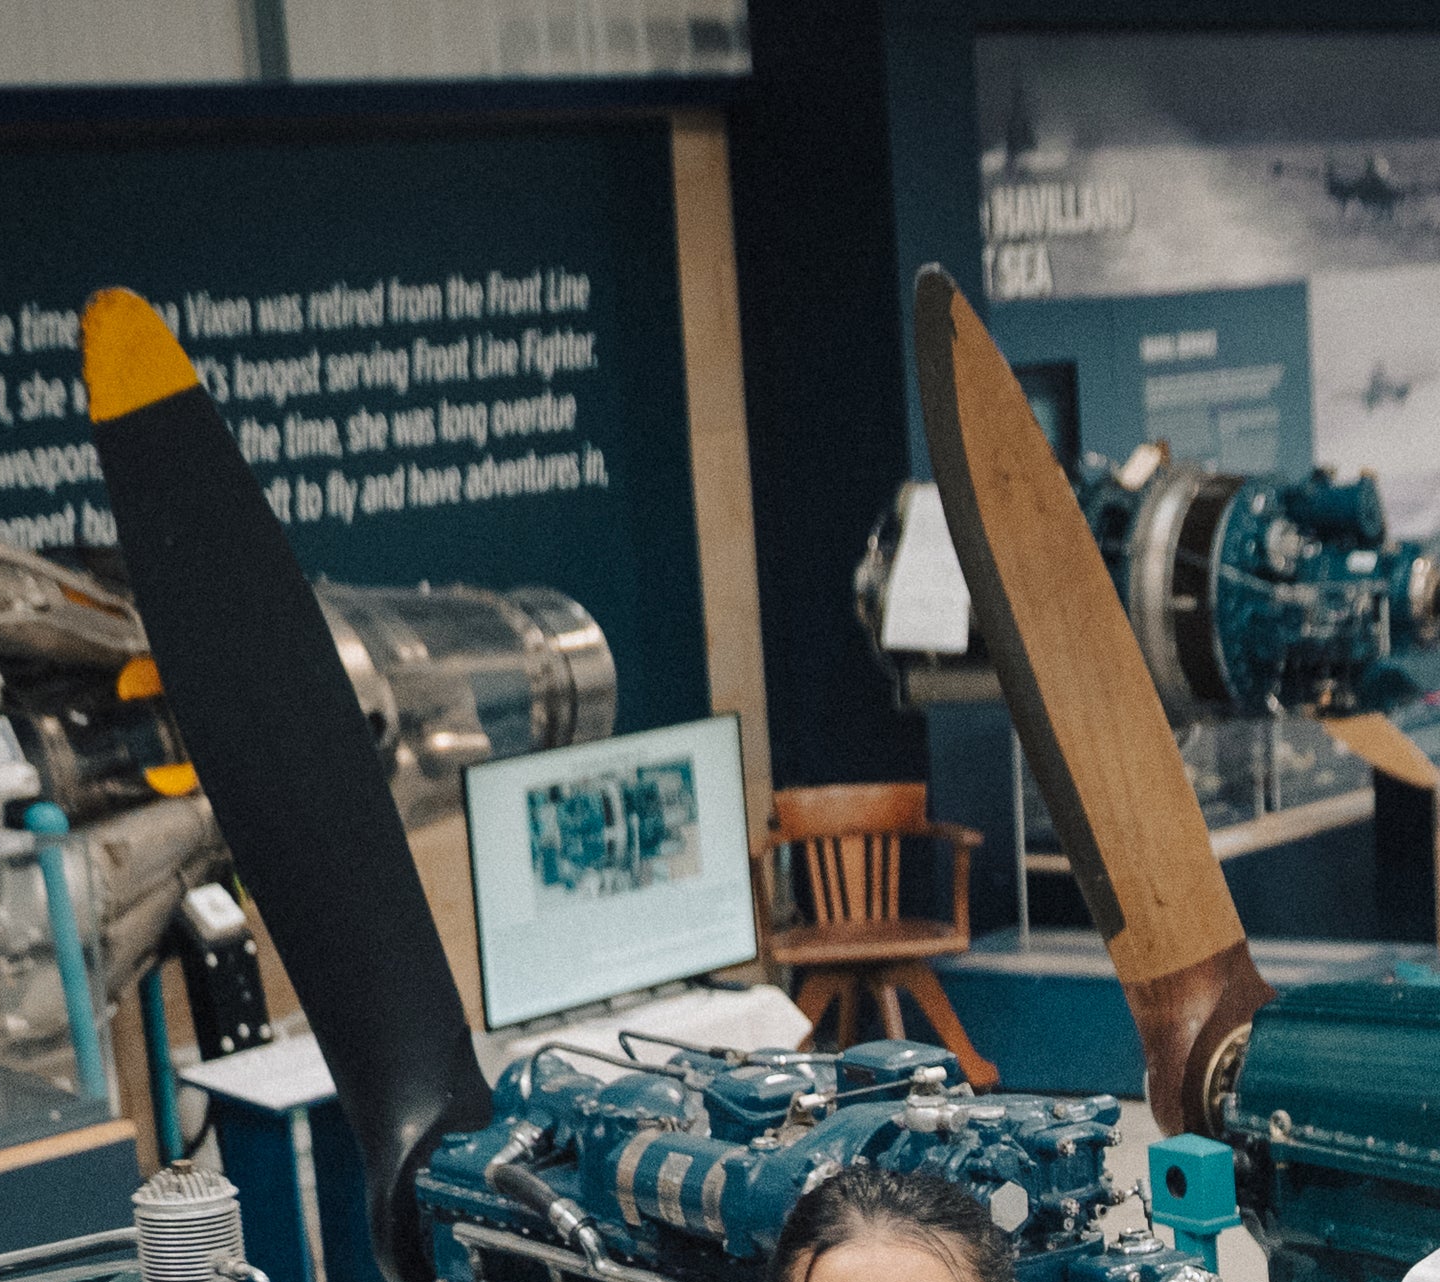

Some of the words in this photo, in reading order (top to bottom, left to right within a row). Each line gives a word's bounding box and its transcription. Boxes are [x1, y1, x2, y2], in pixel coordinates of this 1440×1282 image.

[20, 302, 80, 352] time
[185, 290, 252, 339] Vixen
[257, 293, 304, 333] was
[309, 279, 384, 330] retired
[388, 276, 442, 323] from
[447, 272, 484, 320] the
[487, 269, 542, 317] Front
[545, 266, 590, 313] Line
[19, 372, 67, 421] she
[234, 348, 321, 407] longest
[326, 340, 409, 396] serving
[412, 337, 469, 385] Front
[473, 331, 520, 381] Line
[238, 415, 281, 464] the
[347, 405, 388, 455] she
[392, 405, 436, 448] was
[438, 397, 488, 450] long
[490, 387, 577, 439] overdue
[295, 474, 323, 523] to
[326, 468, 359, 525] fly
[361, 463, 405, 515] and
[408, 461, 461, 507] have
[464, 448, 581, 501] adventures
